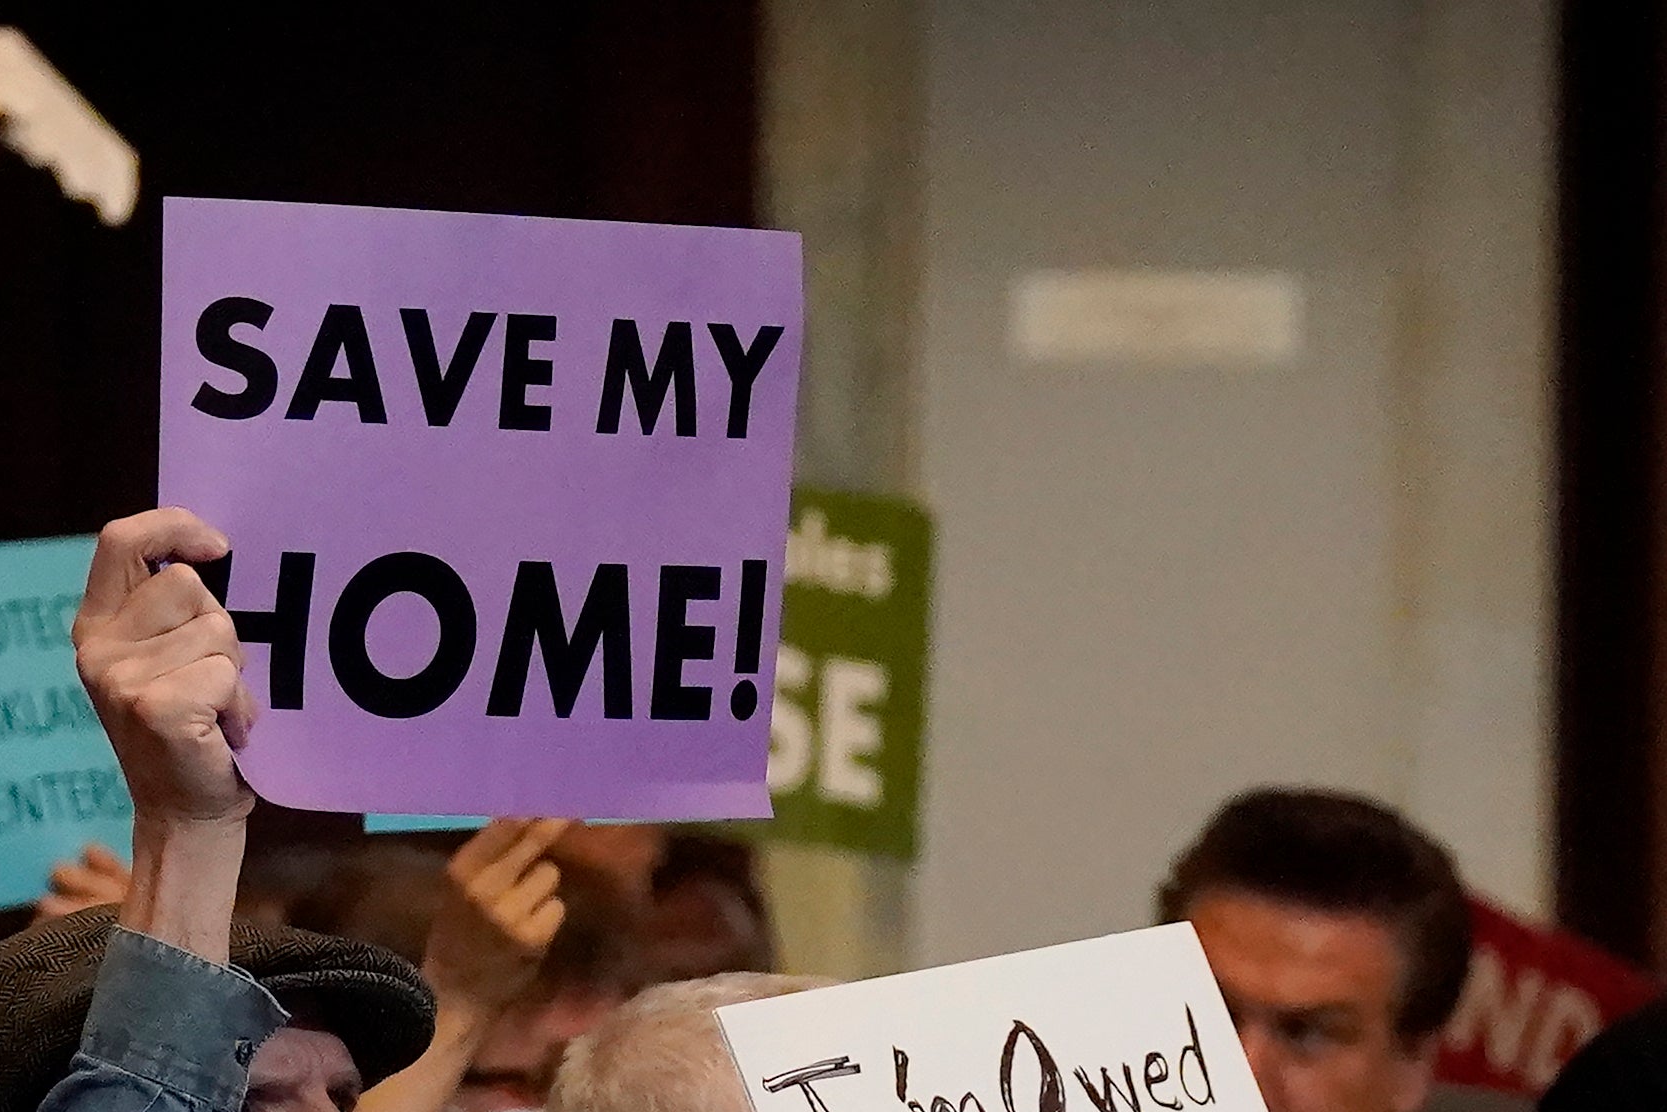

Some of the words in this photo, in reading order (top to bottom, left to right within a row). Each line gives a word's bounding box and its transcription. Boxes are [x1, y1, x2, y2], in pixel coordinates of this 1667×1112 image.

[189, 295, 559, 433] SAVE
[594, 317, 786, 440] MY
[196, 549, 769, 723] HOME!
[1444, 940, 1602, 1085] ND
